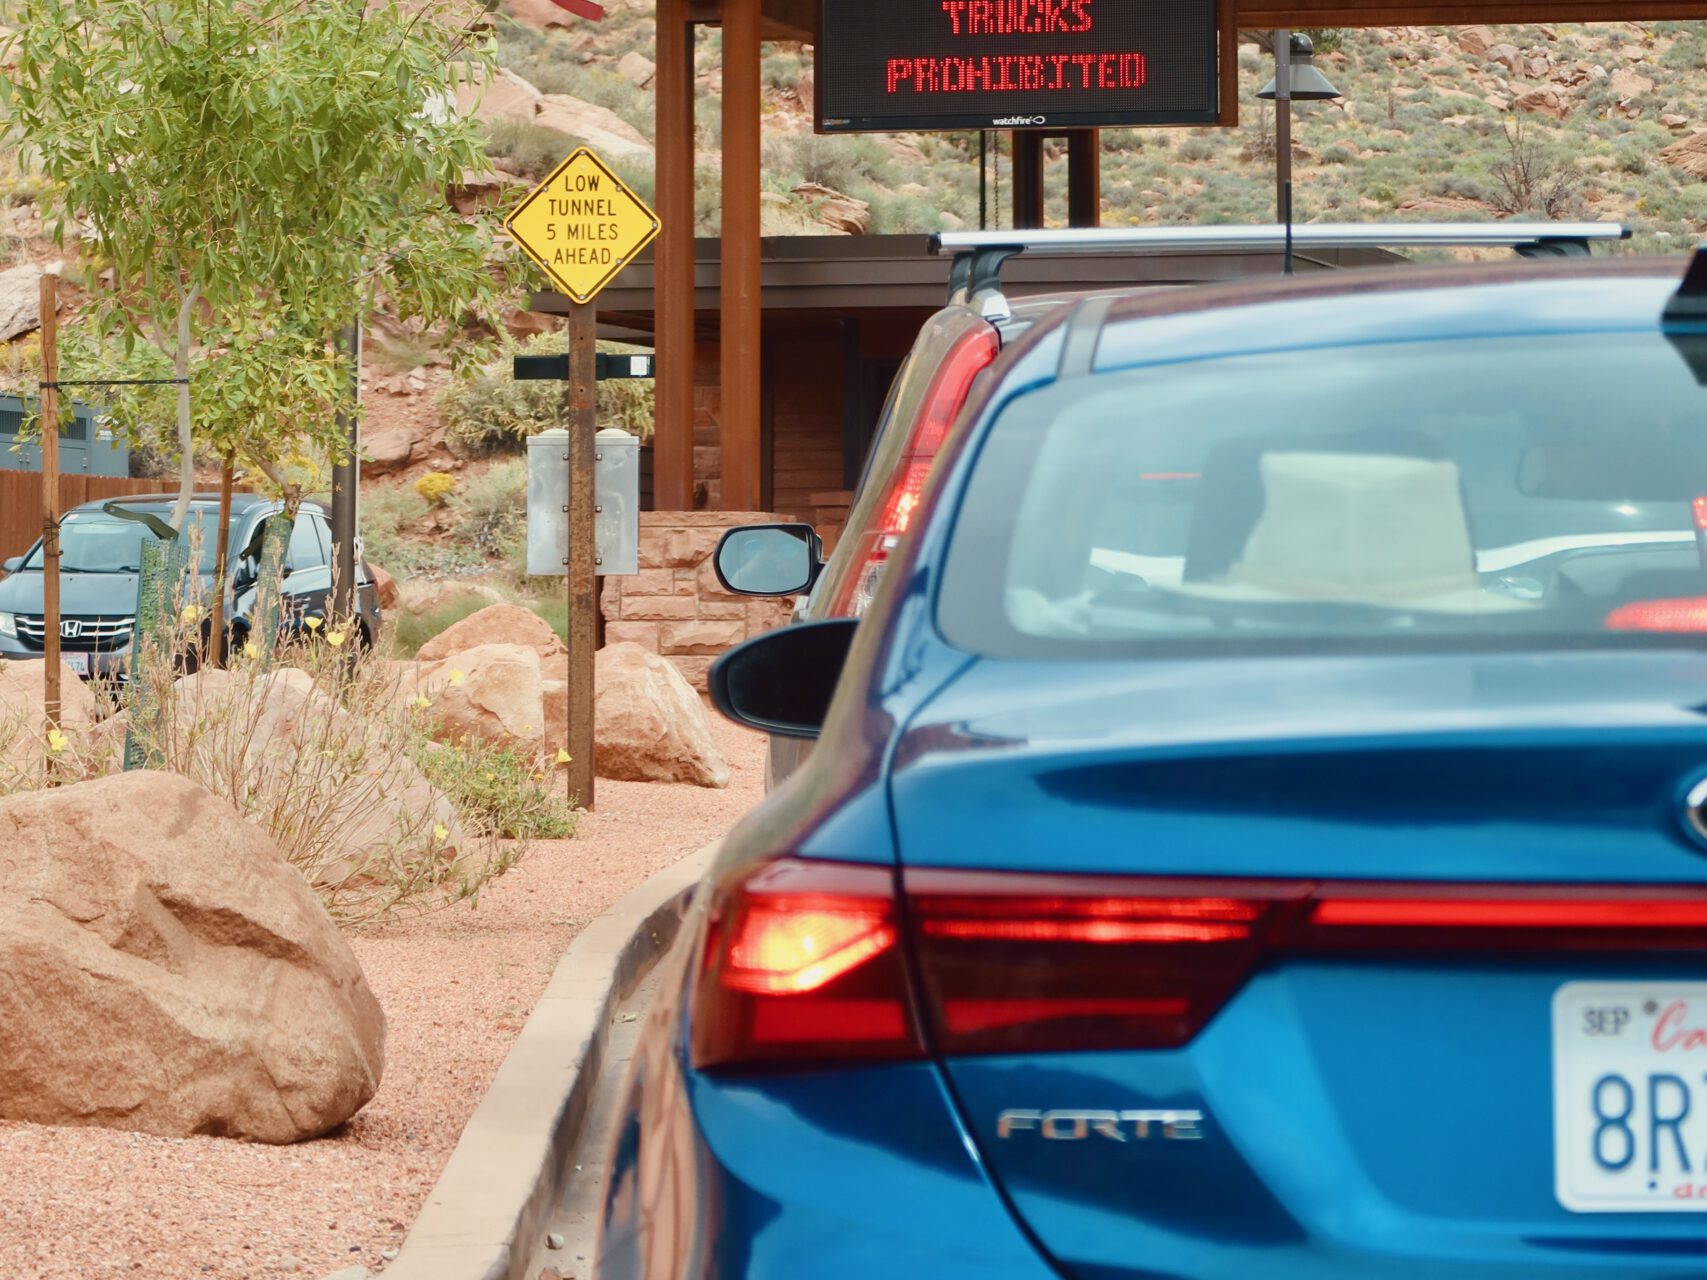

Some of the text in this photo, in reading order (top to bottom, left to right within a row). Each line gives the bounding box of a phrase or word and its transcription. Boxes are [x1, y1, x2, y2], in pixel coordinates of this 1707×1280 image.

[886, 53, 1147, 93] PROHIBITED
[565, 175, 600, 192] LOW
[548, 199, 617, 216] TUNNEL
[546, 223, 619, 241] 5 MILES
[553, 248, 611, 265] AHEAD
[1583, 1005, 1631, 1037] SEP
[997, 1108, 1203, 1142] FORTE
[1590, 1072, 1707, 1173] 8R
